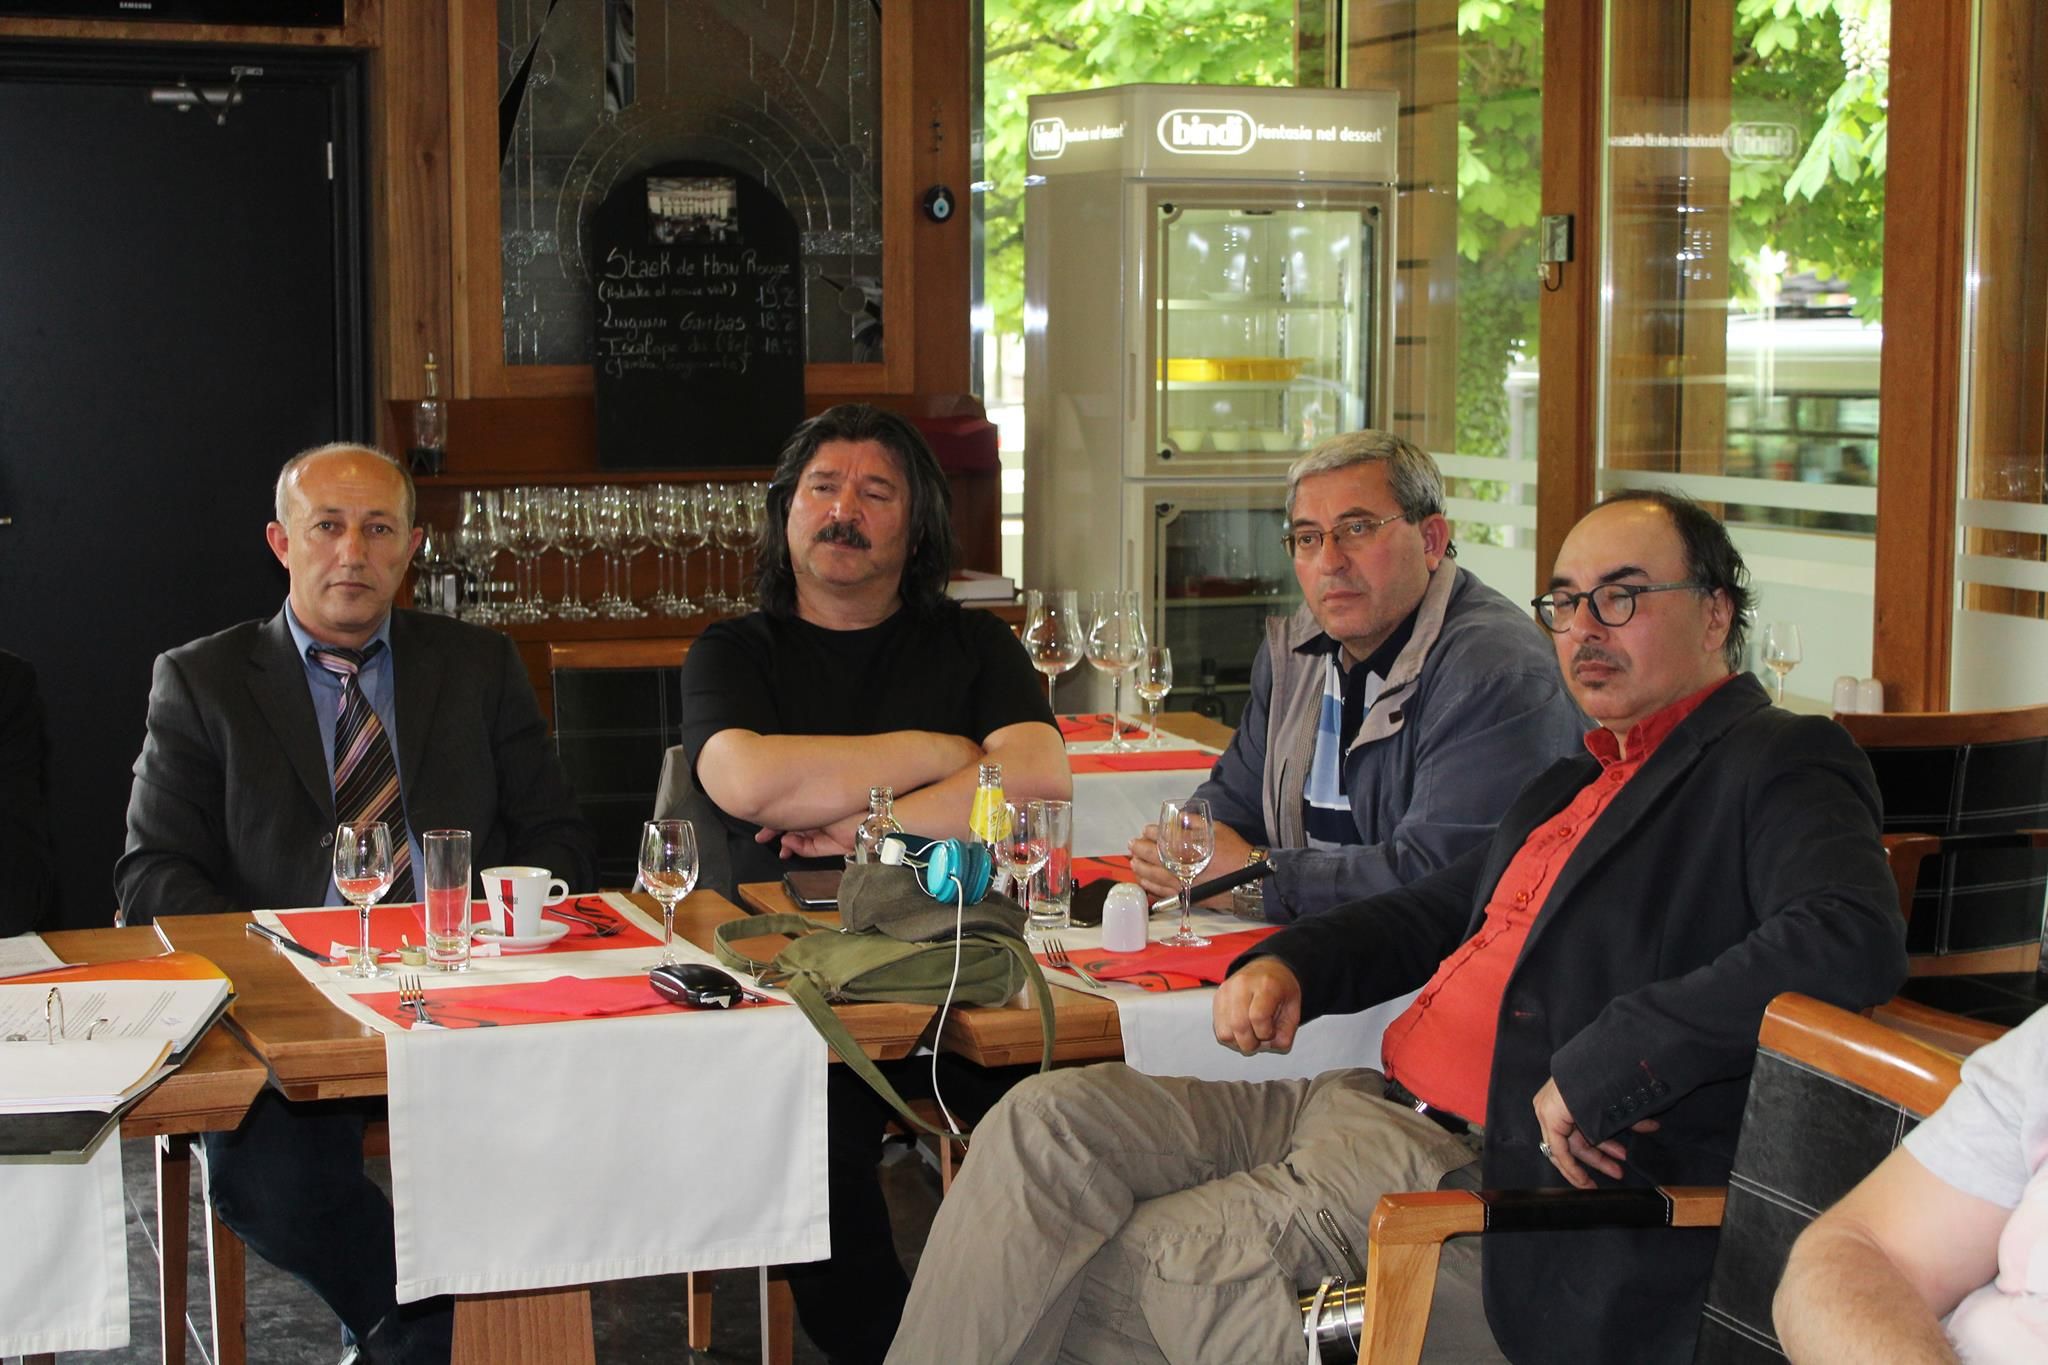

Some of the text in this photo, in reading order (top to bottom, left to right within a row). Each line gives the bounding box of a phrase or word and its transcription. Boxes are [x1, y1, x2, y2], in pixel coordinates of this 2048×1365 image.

[119, 1, 152, 10] SAMSUNG
[1173, 115, 1382, 147] bindi fantasia nel dessert
[676, 256, 695, 276] de
